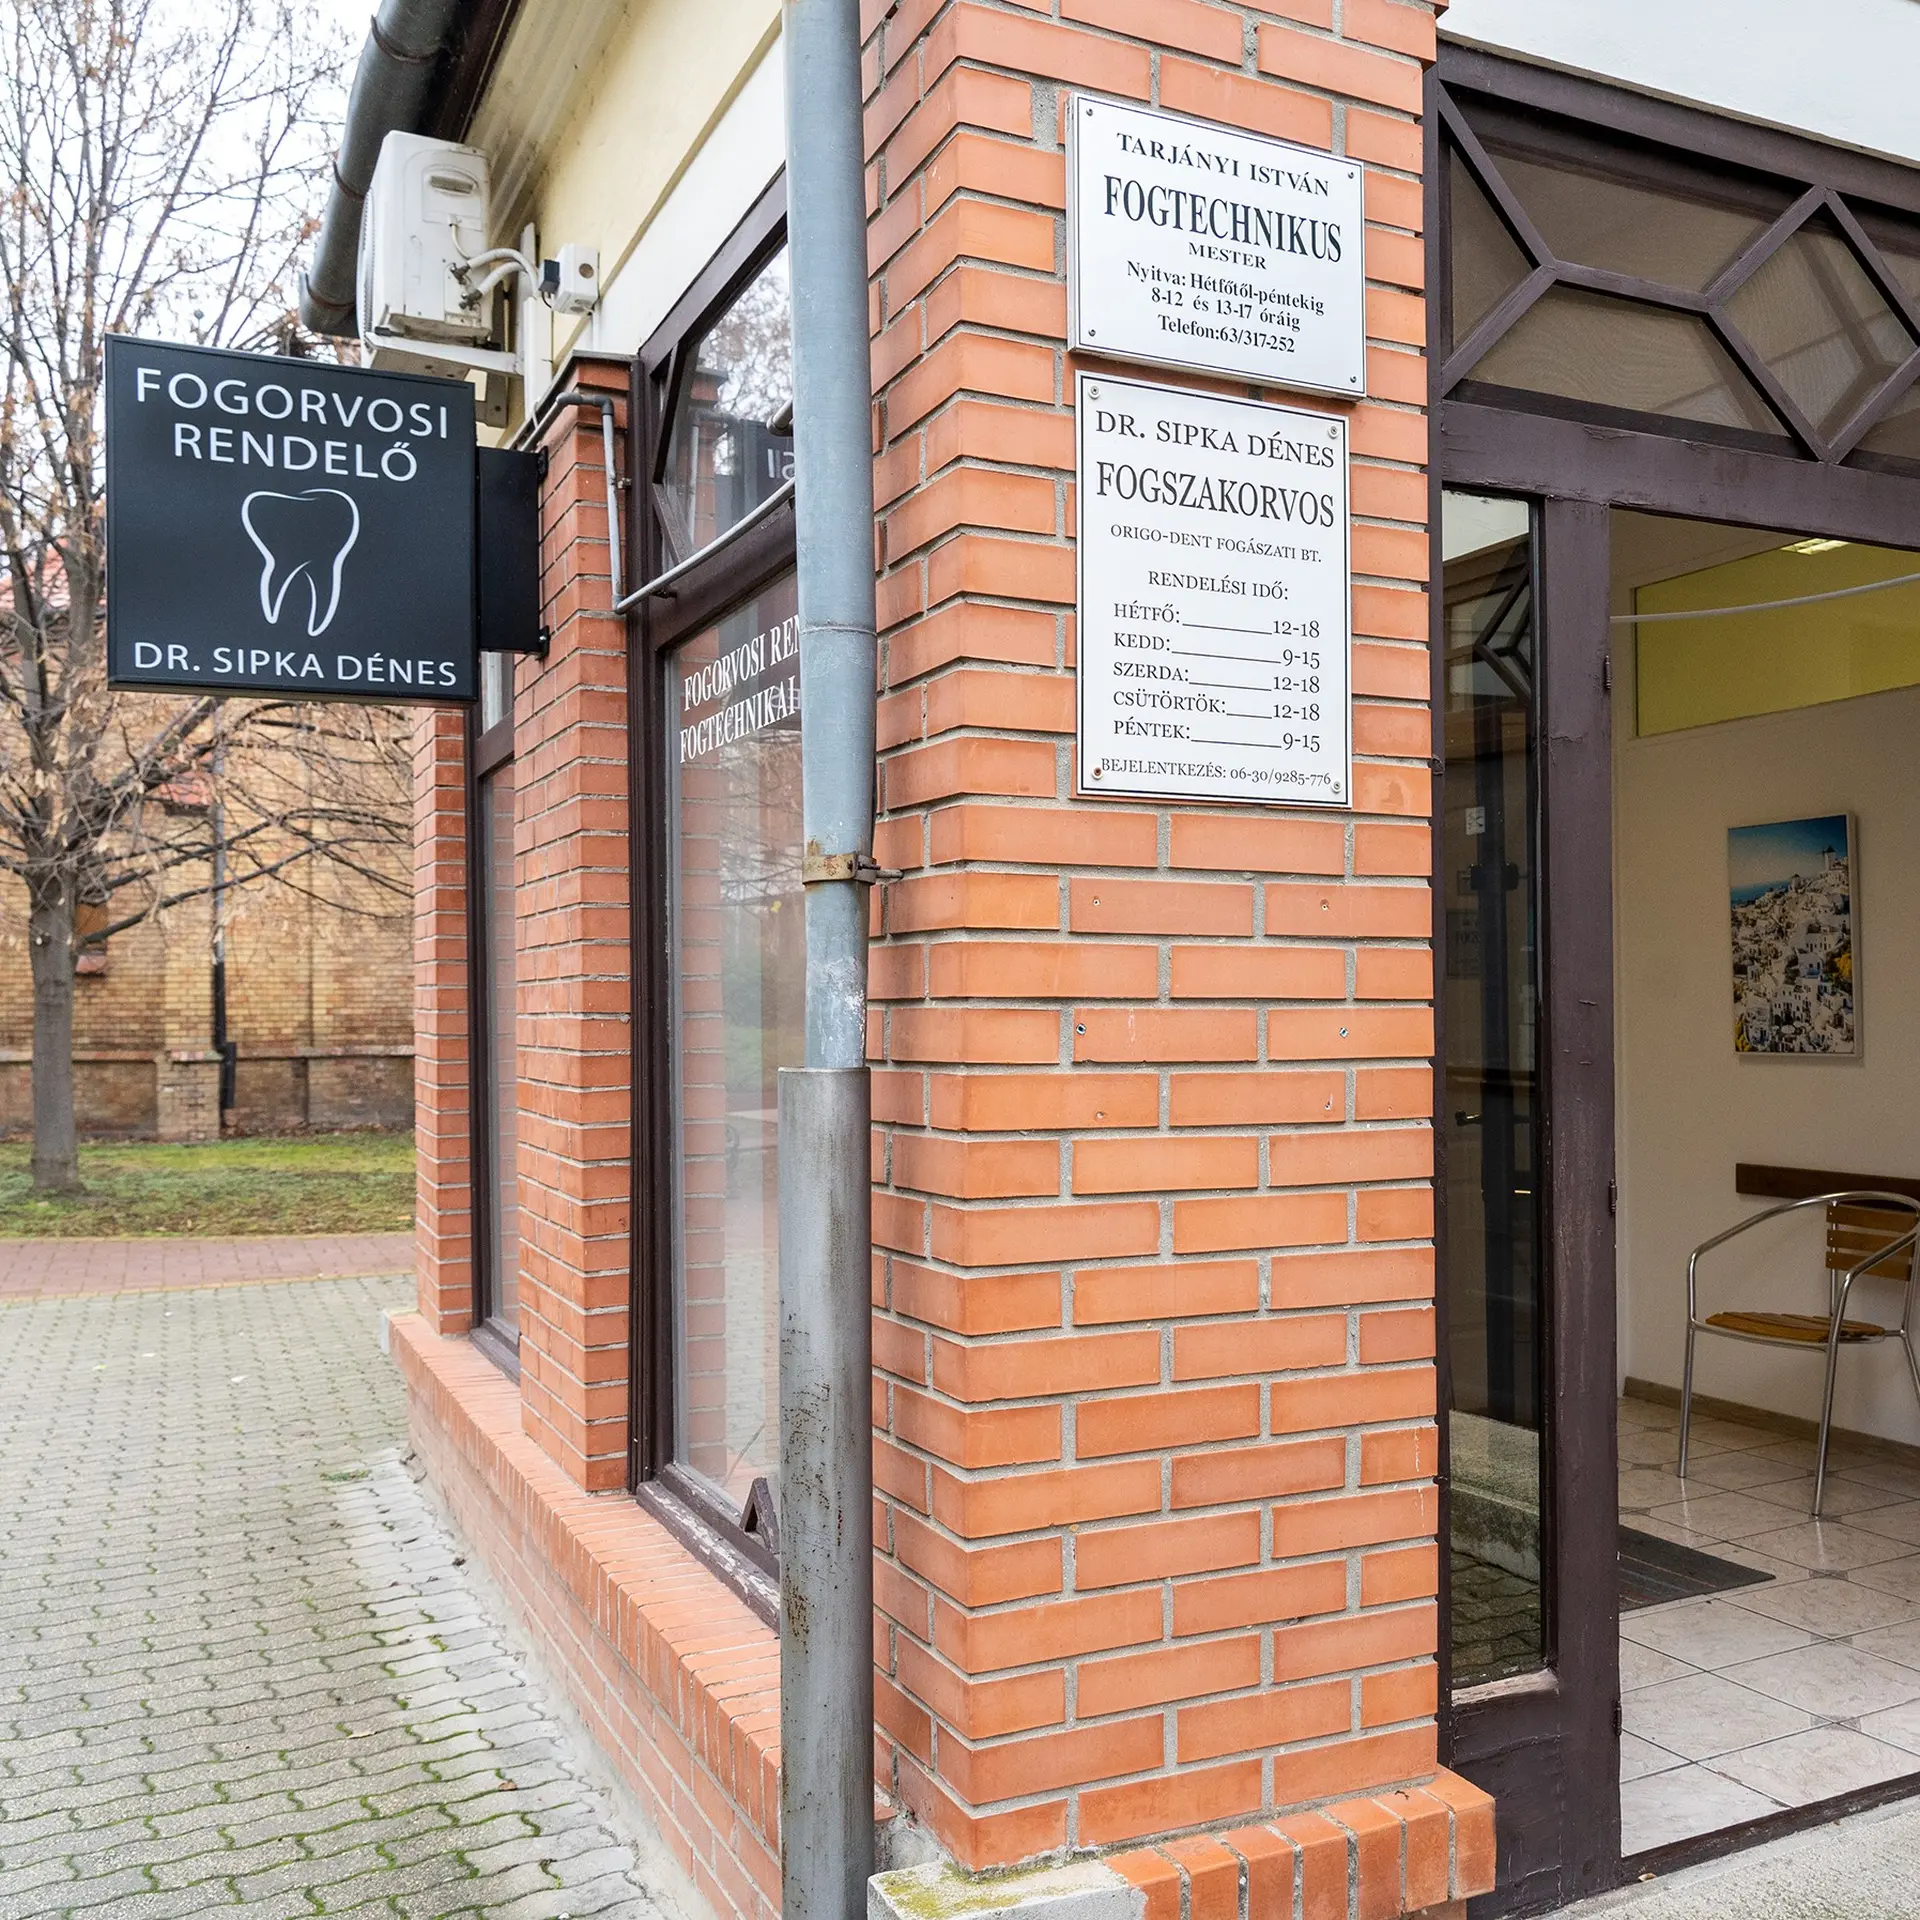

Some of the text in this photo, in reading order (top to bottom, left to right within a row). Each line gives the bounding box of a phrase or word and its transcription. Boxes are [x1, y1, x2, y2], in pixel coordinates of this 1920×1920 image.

[1117, 132, 1329, 197] TARJÁNYI ISTVÁN
[1104, 174, 1342, 263] FOGTECHNIKUS
[1189, 242, 1267, 270] MESTER
[1127, 260, 1325, 316] Nyitva: Hétfőtől-péntekig
[1151, 287, 1300, 332] 8-12 és 13-17 óráig
[1157, 314, 1295, 353] Telefon:63/317-252
[136, 367, 448, 439] FOGORVOSI
[173, 422, 418, 482] RENDELŐ
[1096, 410, 1334, 468] DR. SIPKA DÉNES
[1096, 461, 1335, 528] FOGSZAKORVOS
[1110, 524, 1321, 563] ORIGO-DENT FOGÁSZATI BT.
[1148, 571, 1289, 601] RENDELÉSI IDŐ:
[1113, 600, 1320, 639] HÉTFŐ: 12-18
[134, 641, 457, 687] DR. SIPKA DÉNES
[684, 631, 766, 713] FOGORVOSI
[1113, 632, 1320, 670] KEDD: 9-15
[1113, 662, 1320, 694] SZERDA: 12-18
[679, 675, 796, 764] FOGTECHNIKAI
[1113, 688, 1320, 721] CSÜTÖRTÖK: 12-18
[1113, 717, 1321, 753] PÉNTEK: 9-15
[1101, 757, 1332, 787] BEJELENTKEZÉS: 06-30/9285-776
